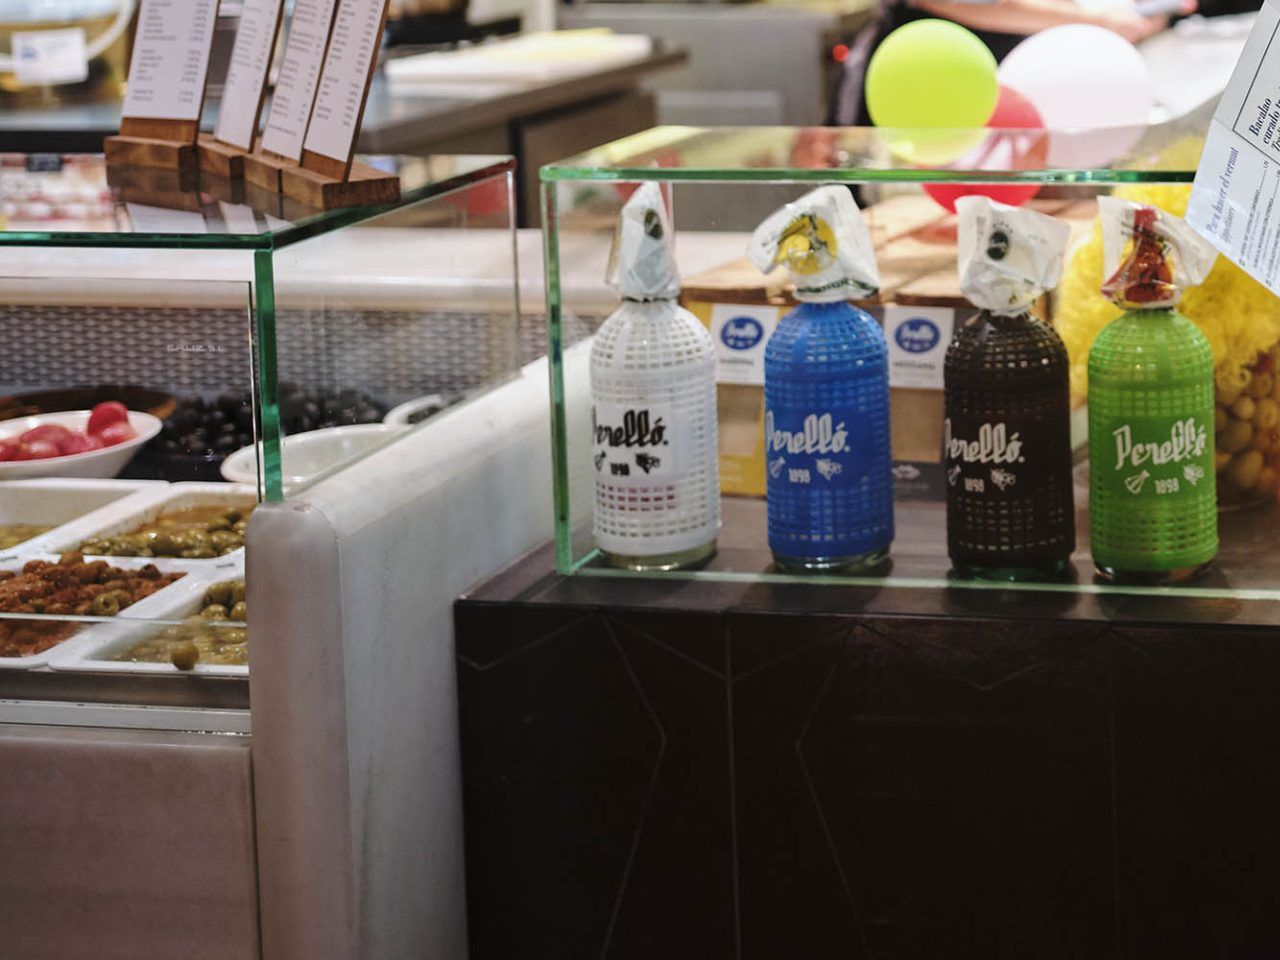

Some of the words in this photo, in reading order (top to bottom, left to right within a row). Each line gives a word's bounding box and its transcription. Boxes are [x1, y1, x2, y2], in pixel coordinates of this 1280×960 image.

[1249, 98, 1272, 136] Bacalao
[1263, 110, 1279, 144] curado
[1224, 146, 1238, 176] vermut
[1218, 175, 1229, 188] el
[1211, 187, 1226, 213] hacer
[1205, 212, 1220, 231] Para
[788, 468, 811, 484] 1898
[964, 477, 985, 493] 1898
[1155, 478, 1180, 495] 1898
